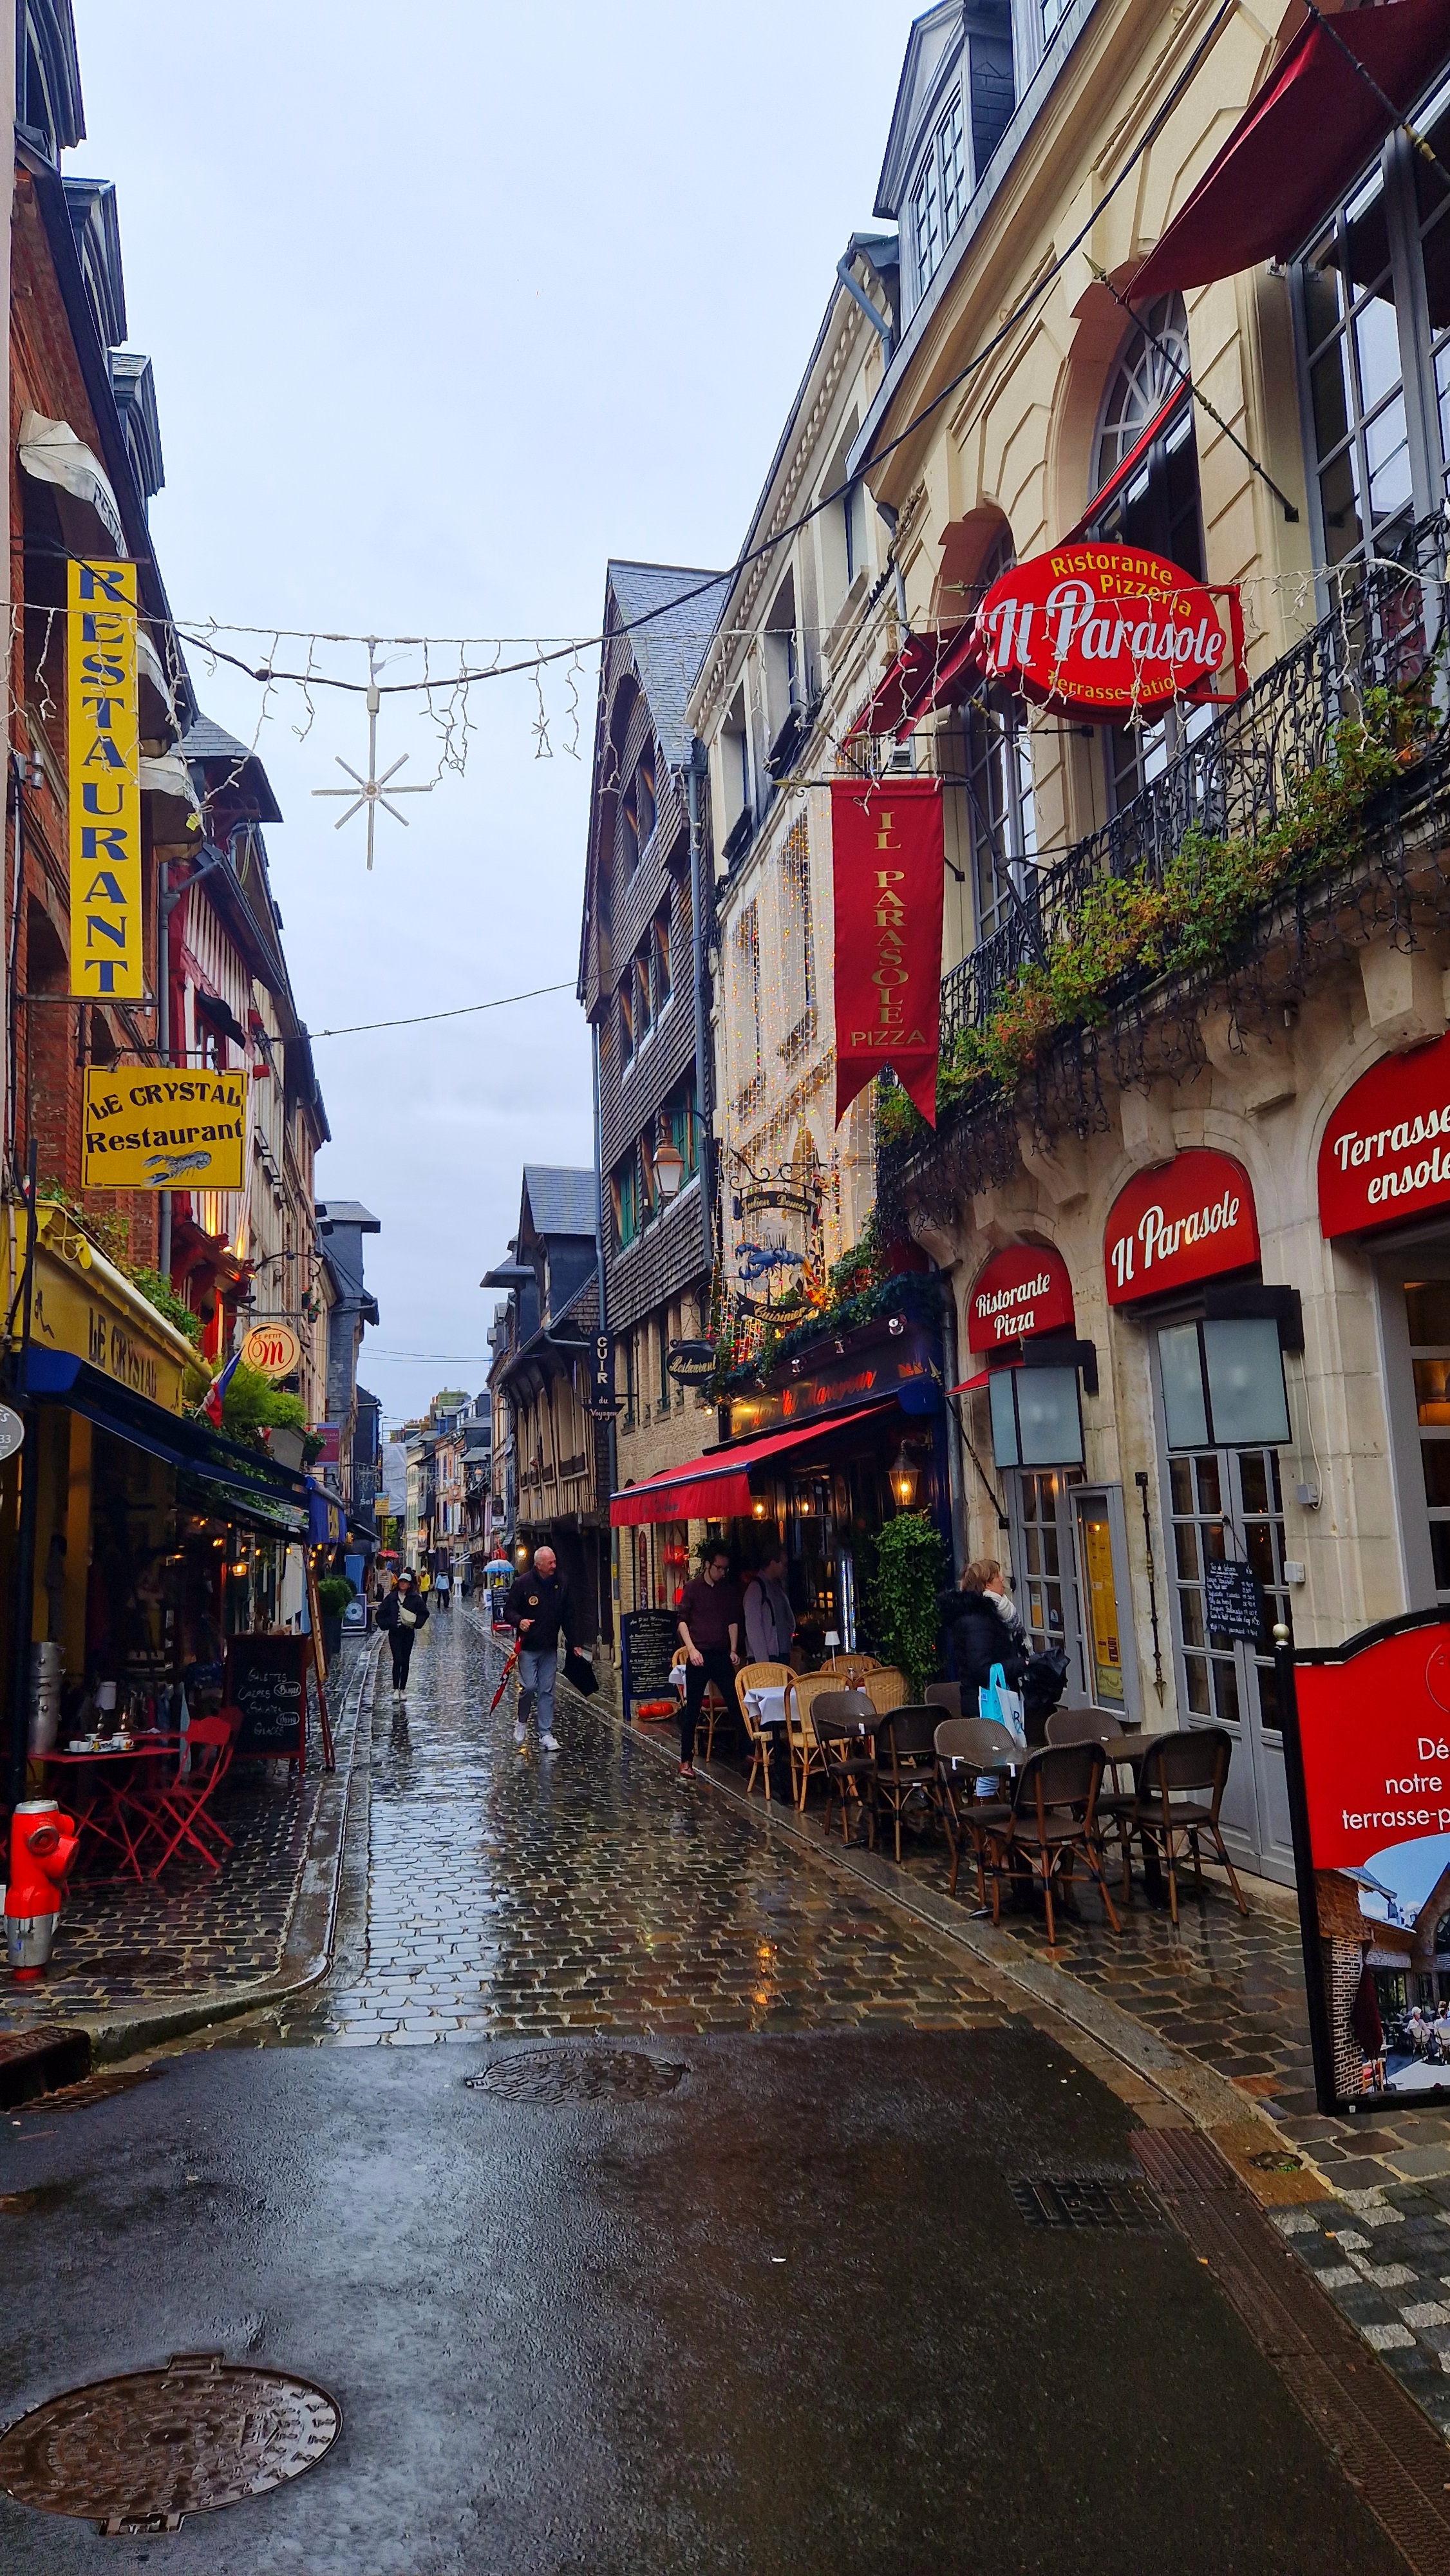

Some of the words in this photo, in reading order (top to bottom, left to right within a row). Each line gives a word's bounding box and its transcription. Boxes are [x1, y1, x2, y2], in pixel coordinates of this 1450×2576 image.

[1050, 551, 1172, 586] Ristorante
[1100, 574, 1192, 617] Pizzeria
[988, 598, 1034, 667] Il
[1045, 580, 1222, 667] Parasole
[1048, 668, 1124, 699] Terrasse
[79, 567, 129, 993] RESTAURANT
[874, 811, 901, 849] IL
[871, 871, 909, 1024] PARASOLE
[851, 1030, 926, 1046] PIZZA
[89, 1094, 124, 1120] LE
[129, 1082, 241, 1107] CRYSTAL
[86, 1117, 244, 1153] Restaurant
[742, 1195, 770, 1217] Julien
[1111, 1235, 1134, 1287] Il
[1138, 1190, 1239, 1269] Parasole
[754, 1304, 807, 1322] Cuisinier
[975, 1273, 1050, 1318] Ristorante
[994, 1311, 1035, 1340] Pizza
[88, 1307, 106, 1368] LE
[110, 1325, 157, 1399] CRYSTAL
[597, 1336, 608, 1384] CUIR
[669, 1354, 716, 1373] Restaurant
[1385, 1773, 1442, 1794] notre
[1342, 1807, 1450, 1831] terrasse-p
